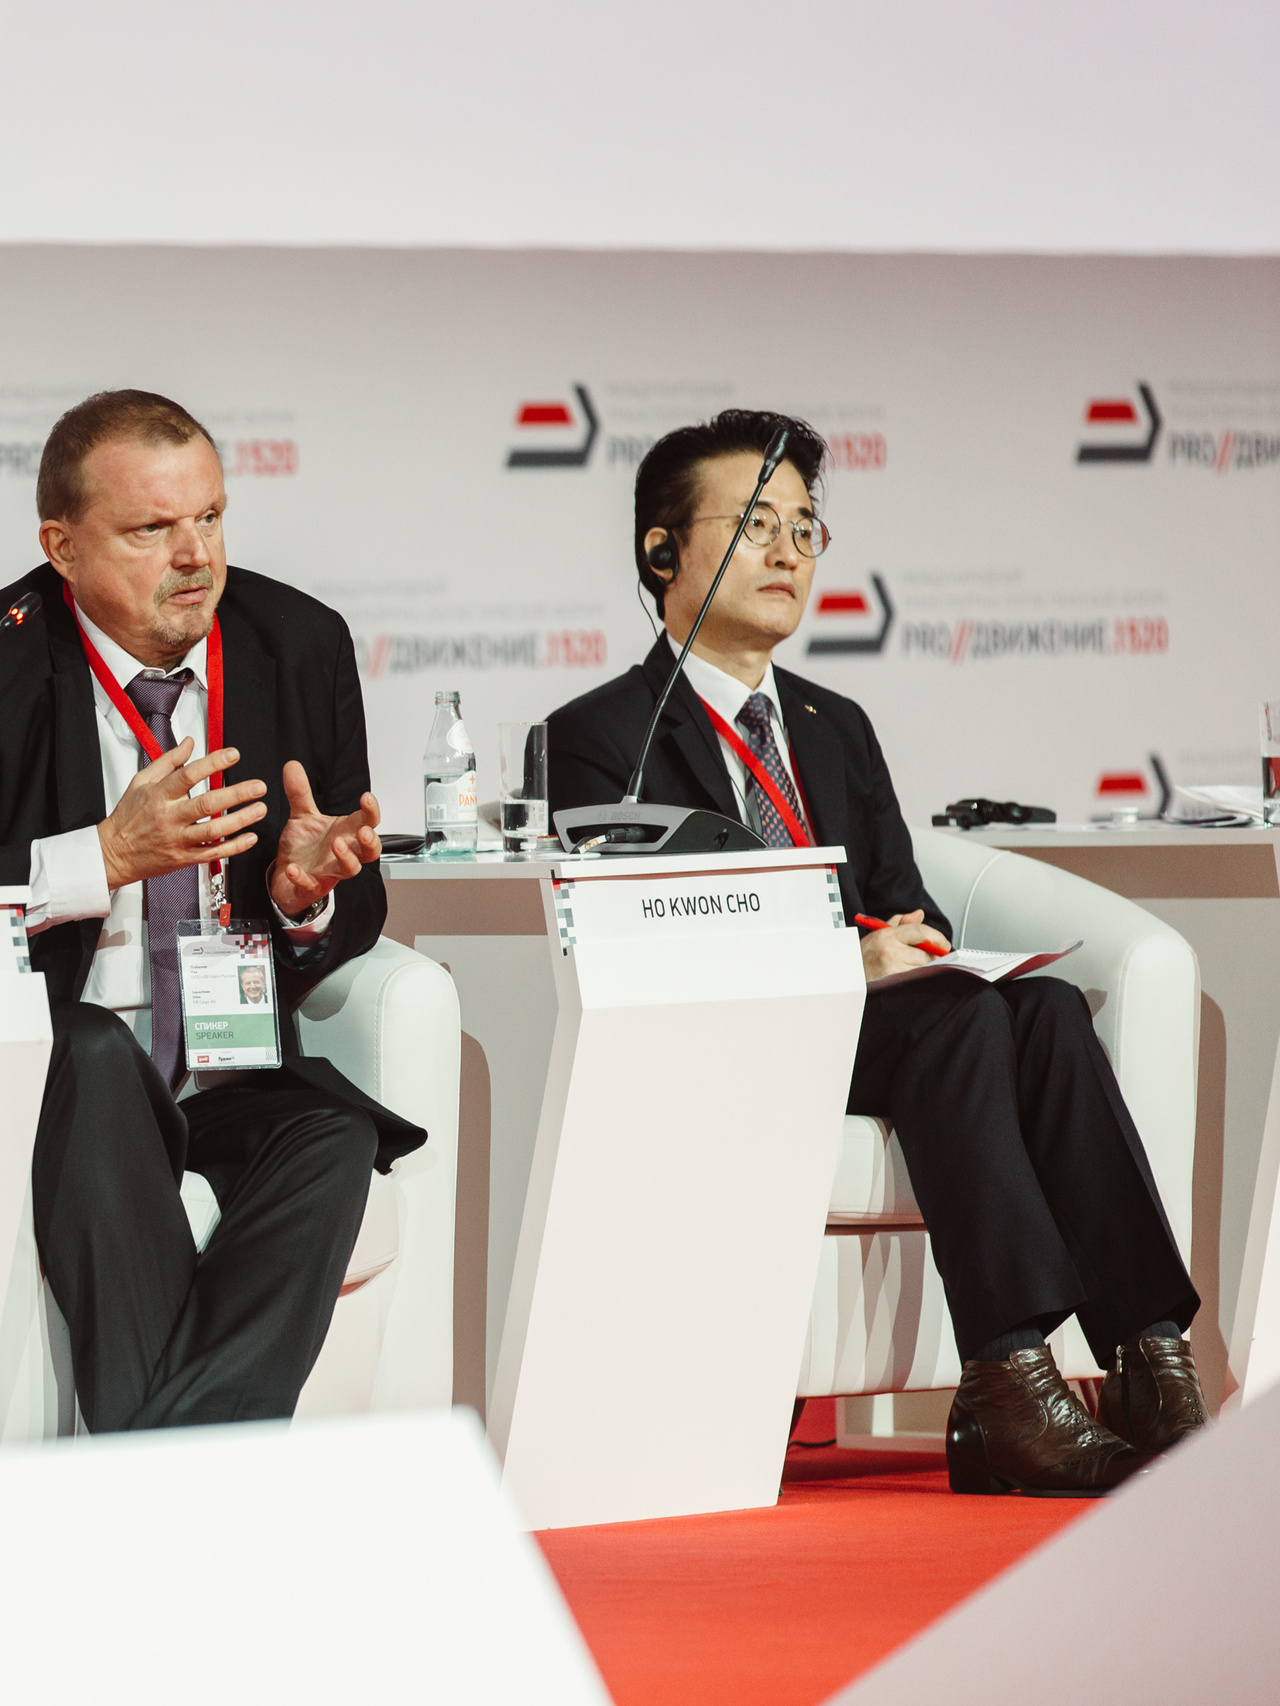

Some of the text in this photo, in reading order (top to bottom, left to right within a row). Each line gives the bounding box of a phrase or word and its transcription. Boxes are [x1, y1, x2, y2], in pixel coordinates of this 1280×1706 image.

[611, 811, 641, 821] BOSCH
[642, 893, 760, 918] HO KWON CHO
[194, 1021, 229, 1031] СПИКЕР
[196, 1031, 234, 1040] SPEAKER
